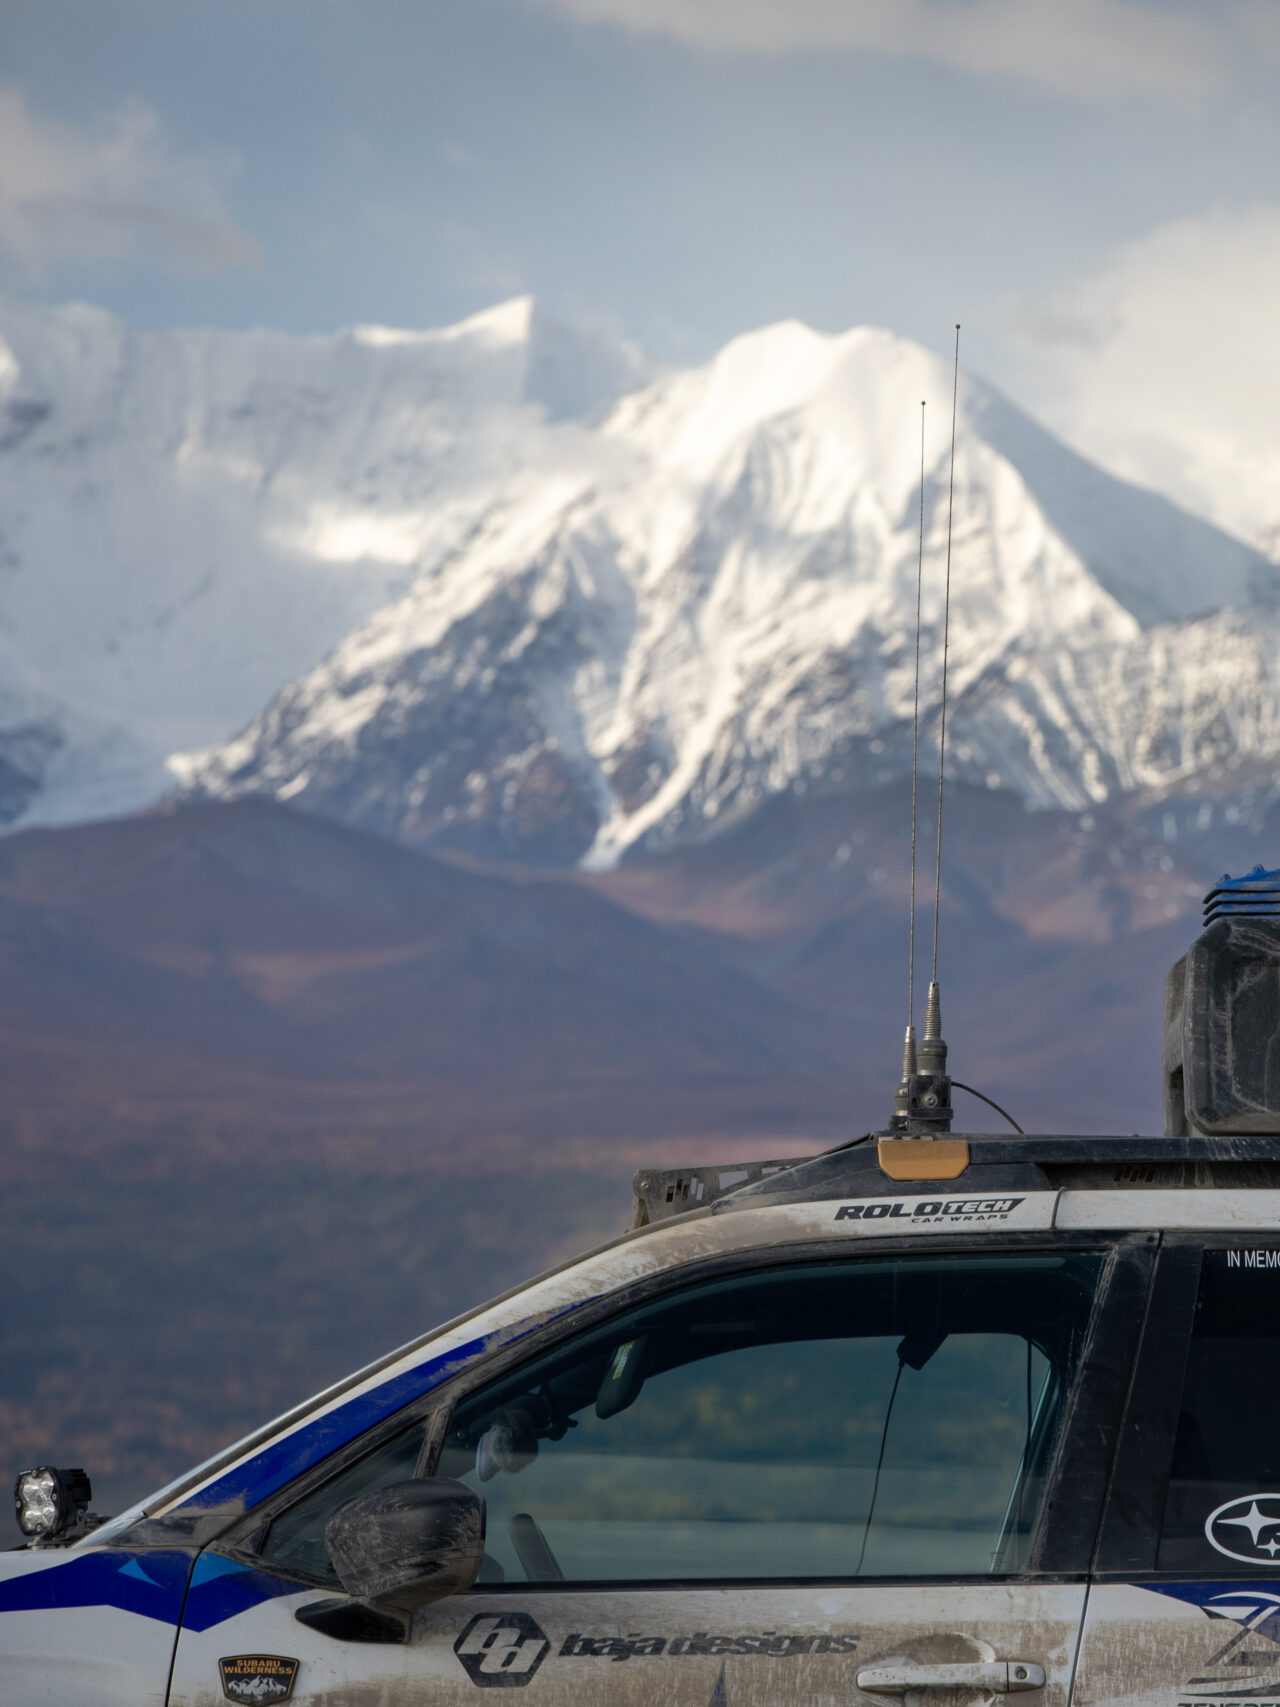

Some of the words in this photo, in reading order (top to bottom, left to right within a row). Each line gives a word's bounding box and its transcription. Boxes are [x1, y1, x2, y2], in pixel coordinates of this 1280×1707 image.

[950, 1213, 1009, 1221] WRAPS
[1227, 1251, 1240, 1267] IN
[224, 1666, 293, 1674] WILDERNESS
